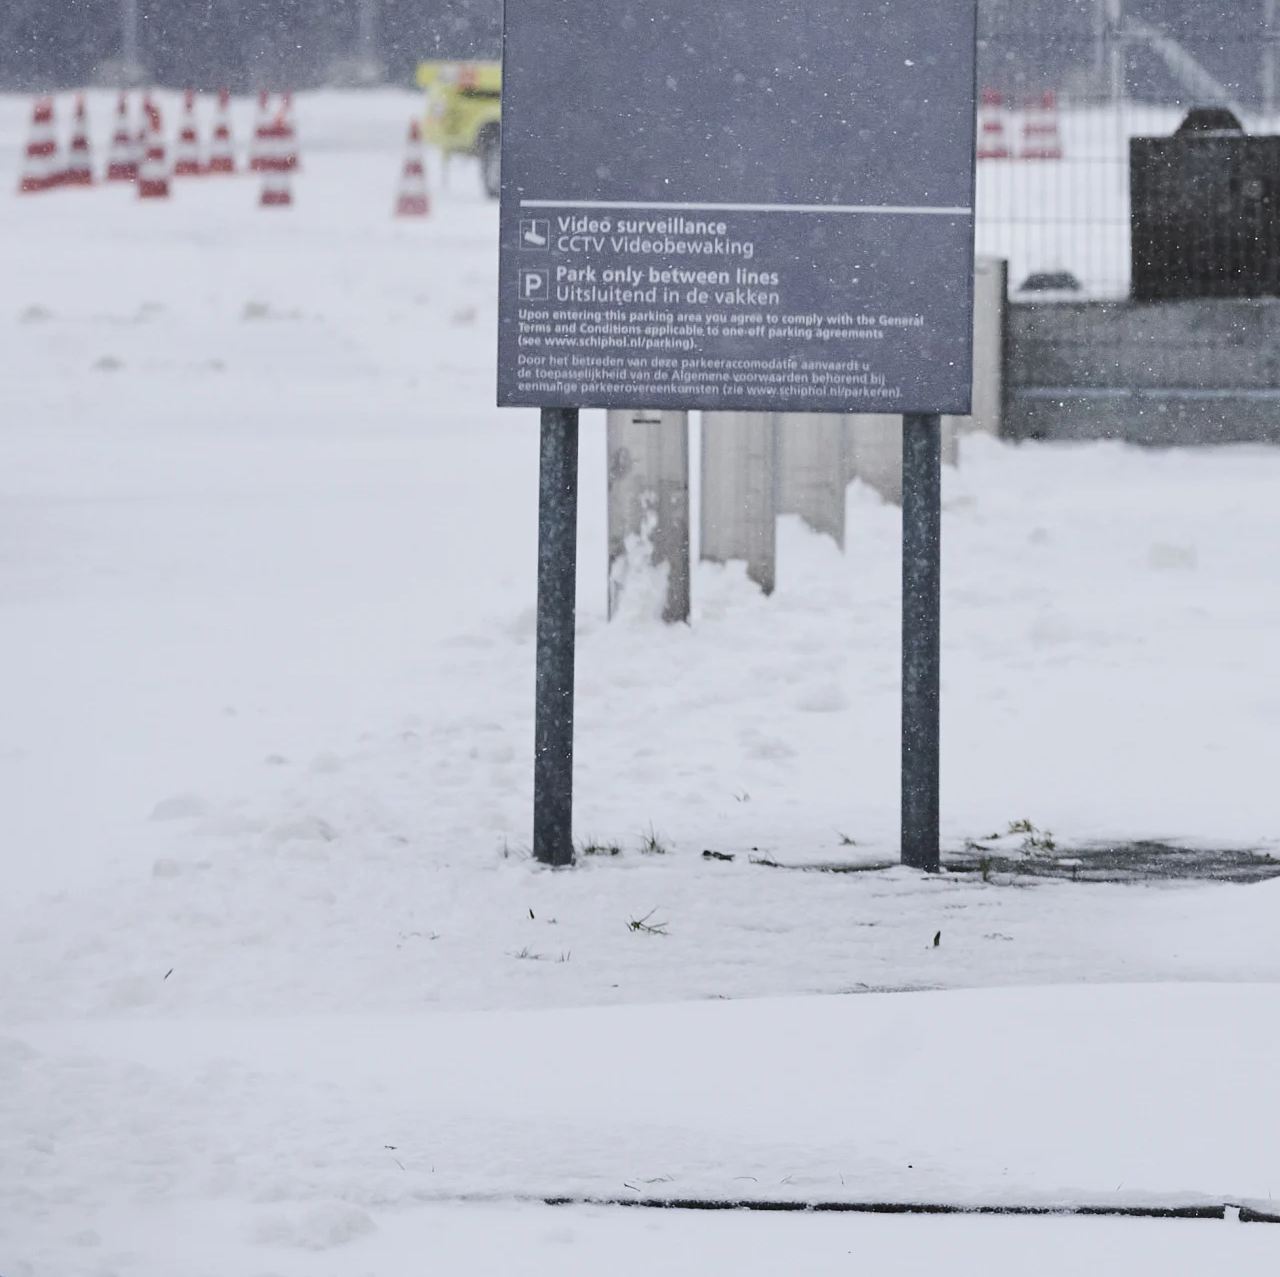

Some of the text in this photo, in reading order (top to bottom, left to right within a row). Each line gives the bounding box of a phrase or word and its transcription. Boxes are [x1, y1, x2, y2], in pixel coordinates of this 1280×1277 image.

[557, 215, 727, 235] Video surveillance
[557, 235, 754, 259] CCTV Videobewaking
[525, 273, 542, 296] P
[556, 265, 779, 286] Park only between lines
[556, 285, 780, 305] Uitsluitend in de vakken
[518, 309, 924, 326] Upon entering this parking area you agree to comply with the General
[519, 323, 551, 334] Terms
[554, 323, 576, 334] and
[580, 324, 641, 335] Conditions
[645, 324, 703, 337] applicable
[707, 325, 719, 336] to
[768, 326, 812, 339] parking
[815, 327, 884, 340] agreements
[518, 336, 698, 349] (see www.schiphol.nl/parking).
[518, 354, 546, 365] Door
[550, 355, 568, 365] het
[572, 356, 624, 366] betreden
[627, 358, 648, 367] van
[651, 356, 677, 367] deze
[801, 360, 859, 371] aanvaardt
[862, 363, 870, 371] u
[518, 368, 886, 386] de toepasselijkheid van de Algemene voorwaarden behorend bij
